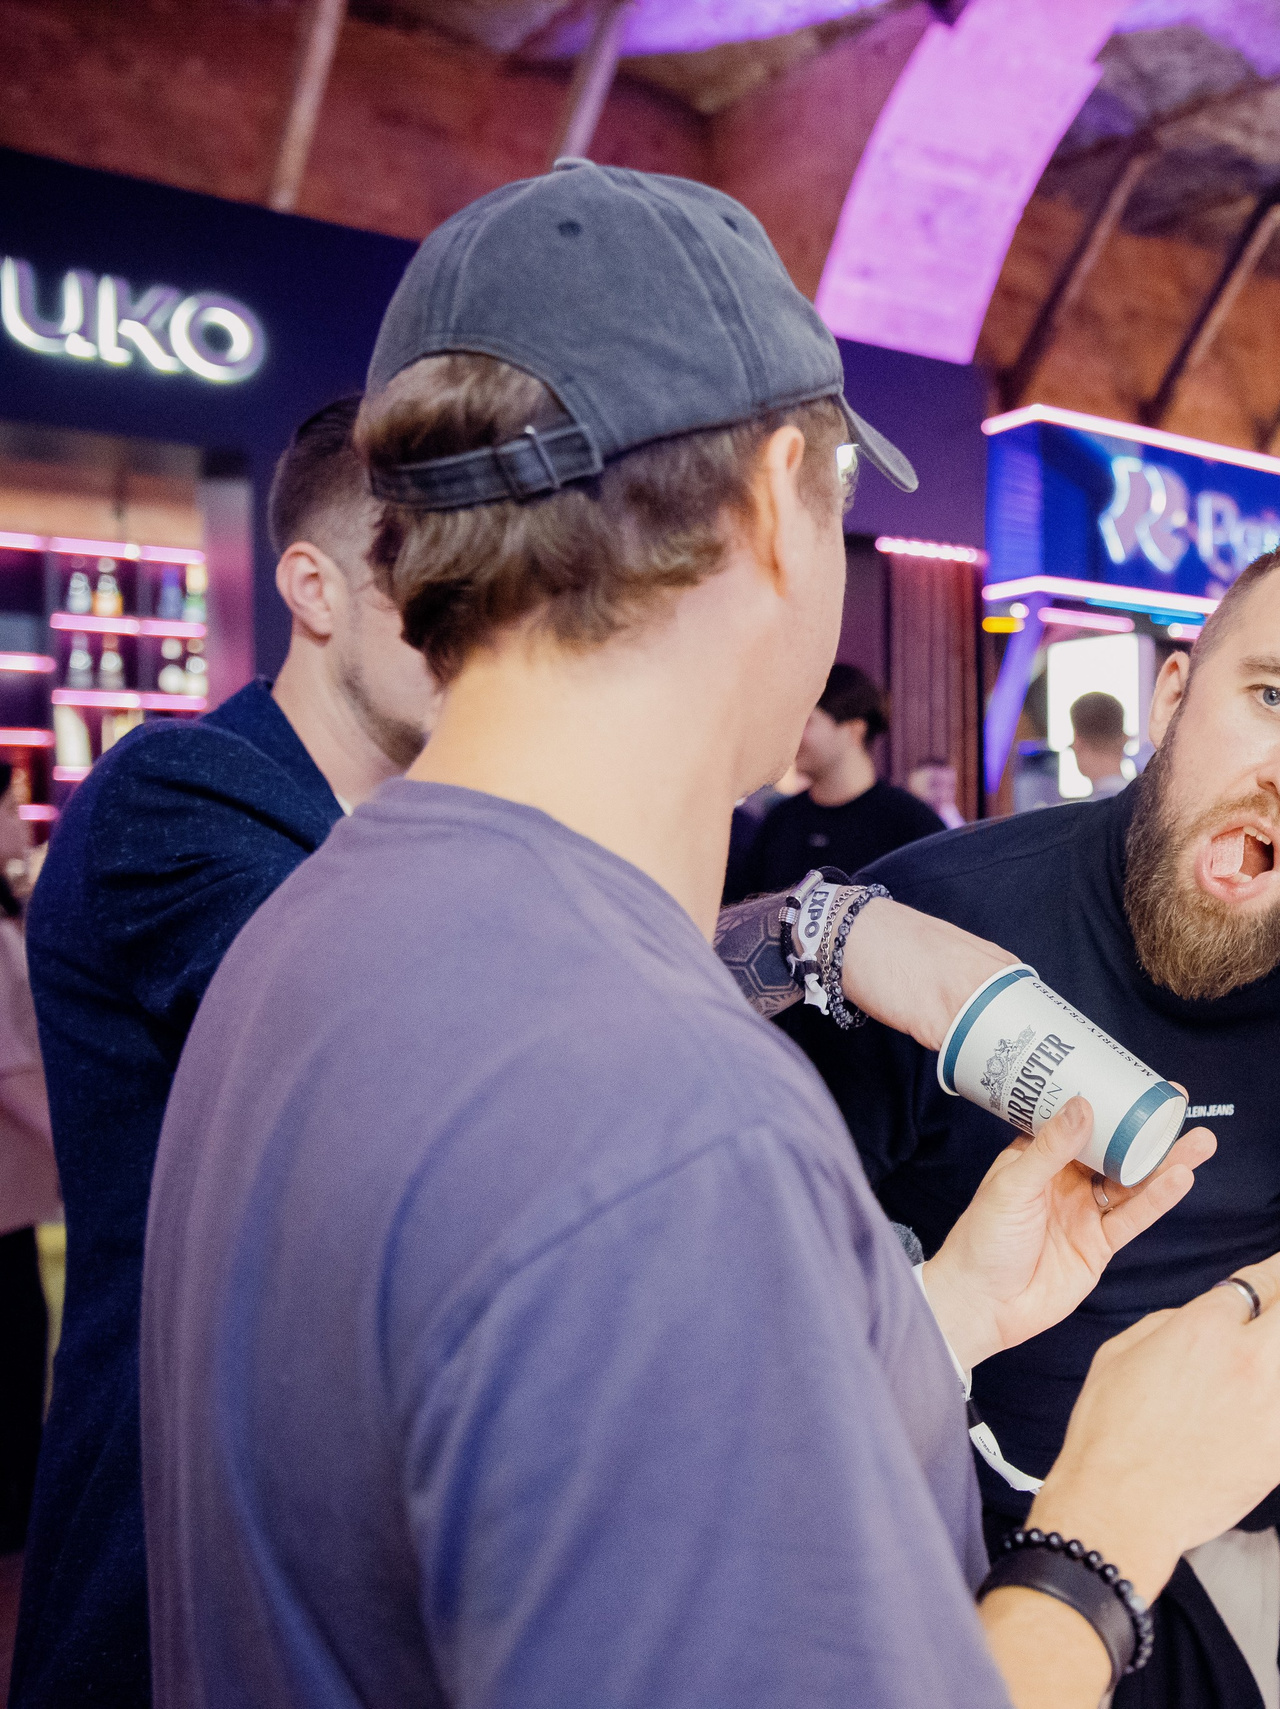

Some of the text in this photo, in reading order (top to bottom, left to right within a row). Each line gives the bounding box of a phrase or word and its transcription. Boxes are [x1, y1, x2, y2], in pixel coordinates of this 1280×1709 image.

[804, 892, 829, 938] EXPO
[1032, 982, 1086, 1024] CRAFTED
[1088, 1026, 1154, 1077] MASTERLY
[1038, 1081, 1063, 1120] GIN
[1207, 1103, 1235, 1117] JEANS
